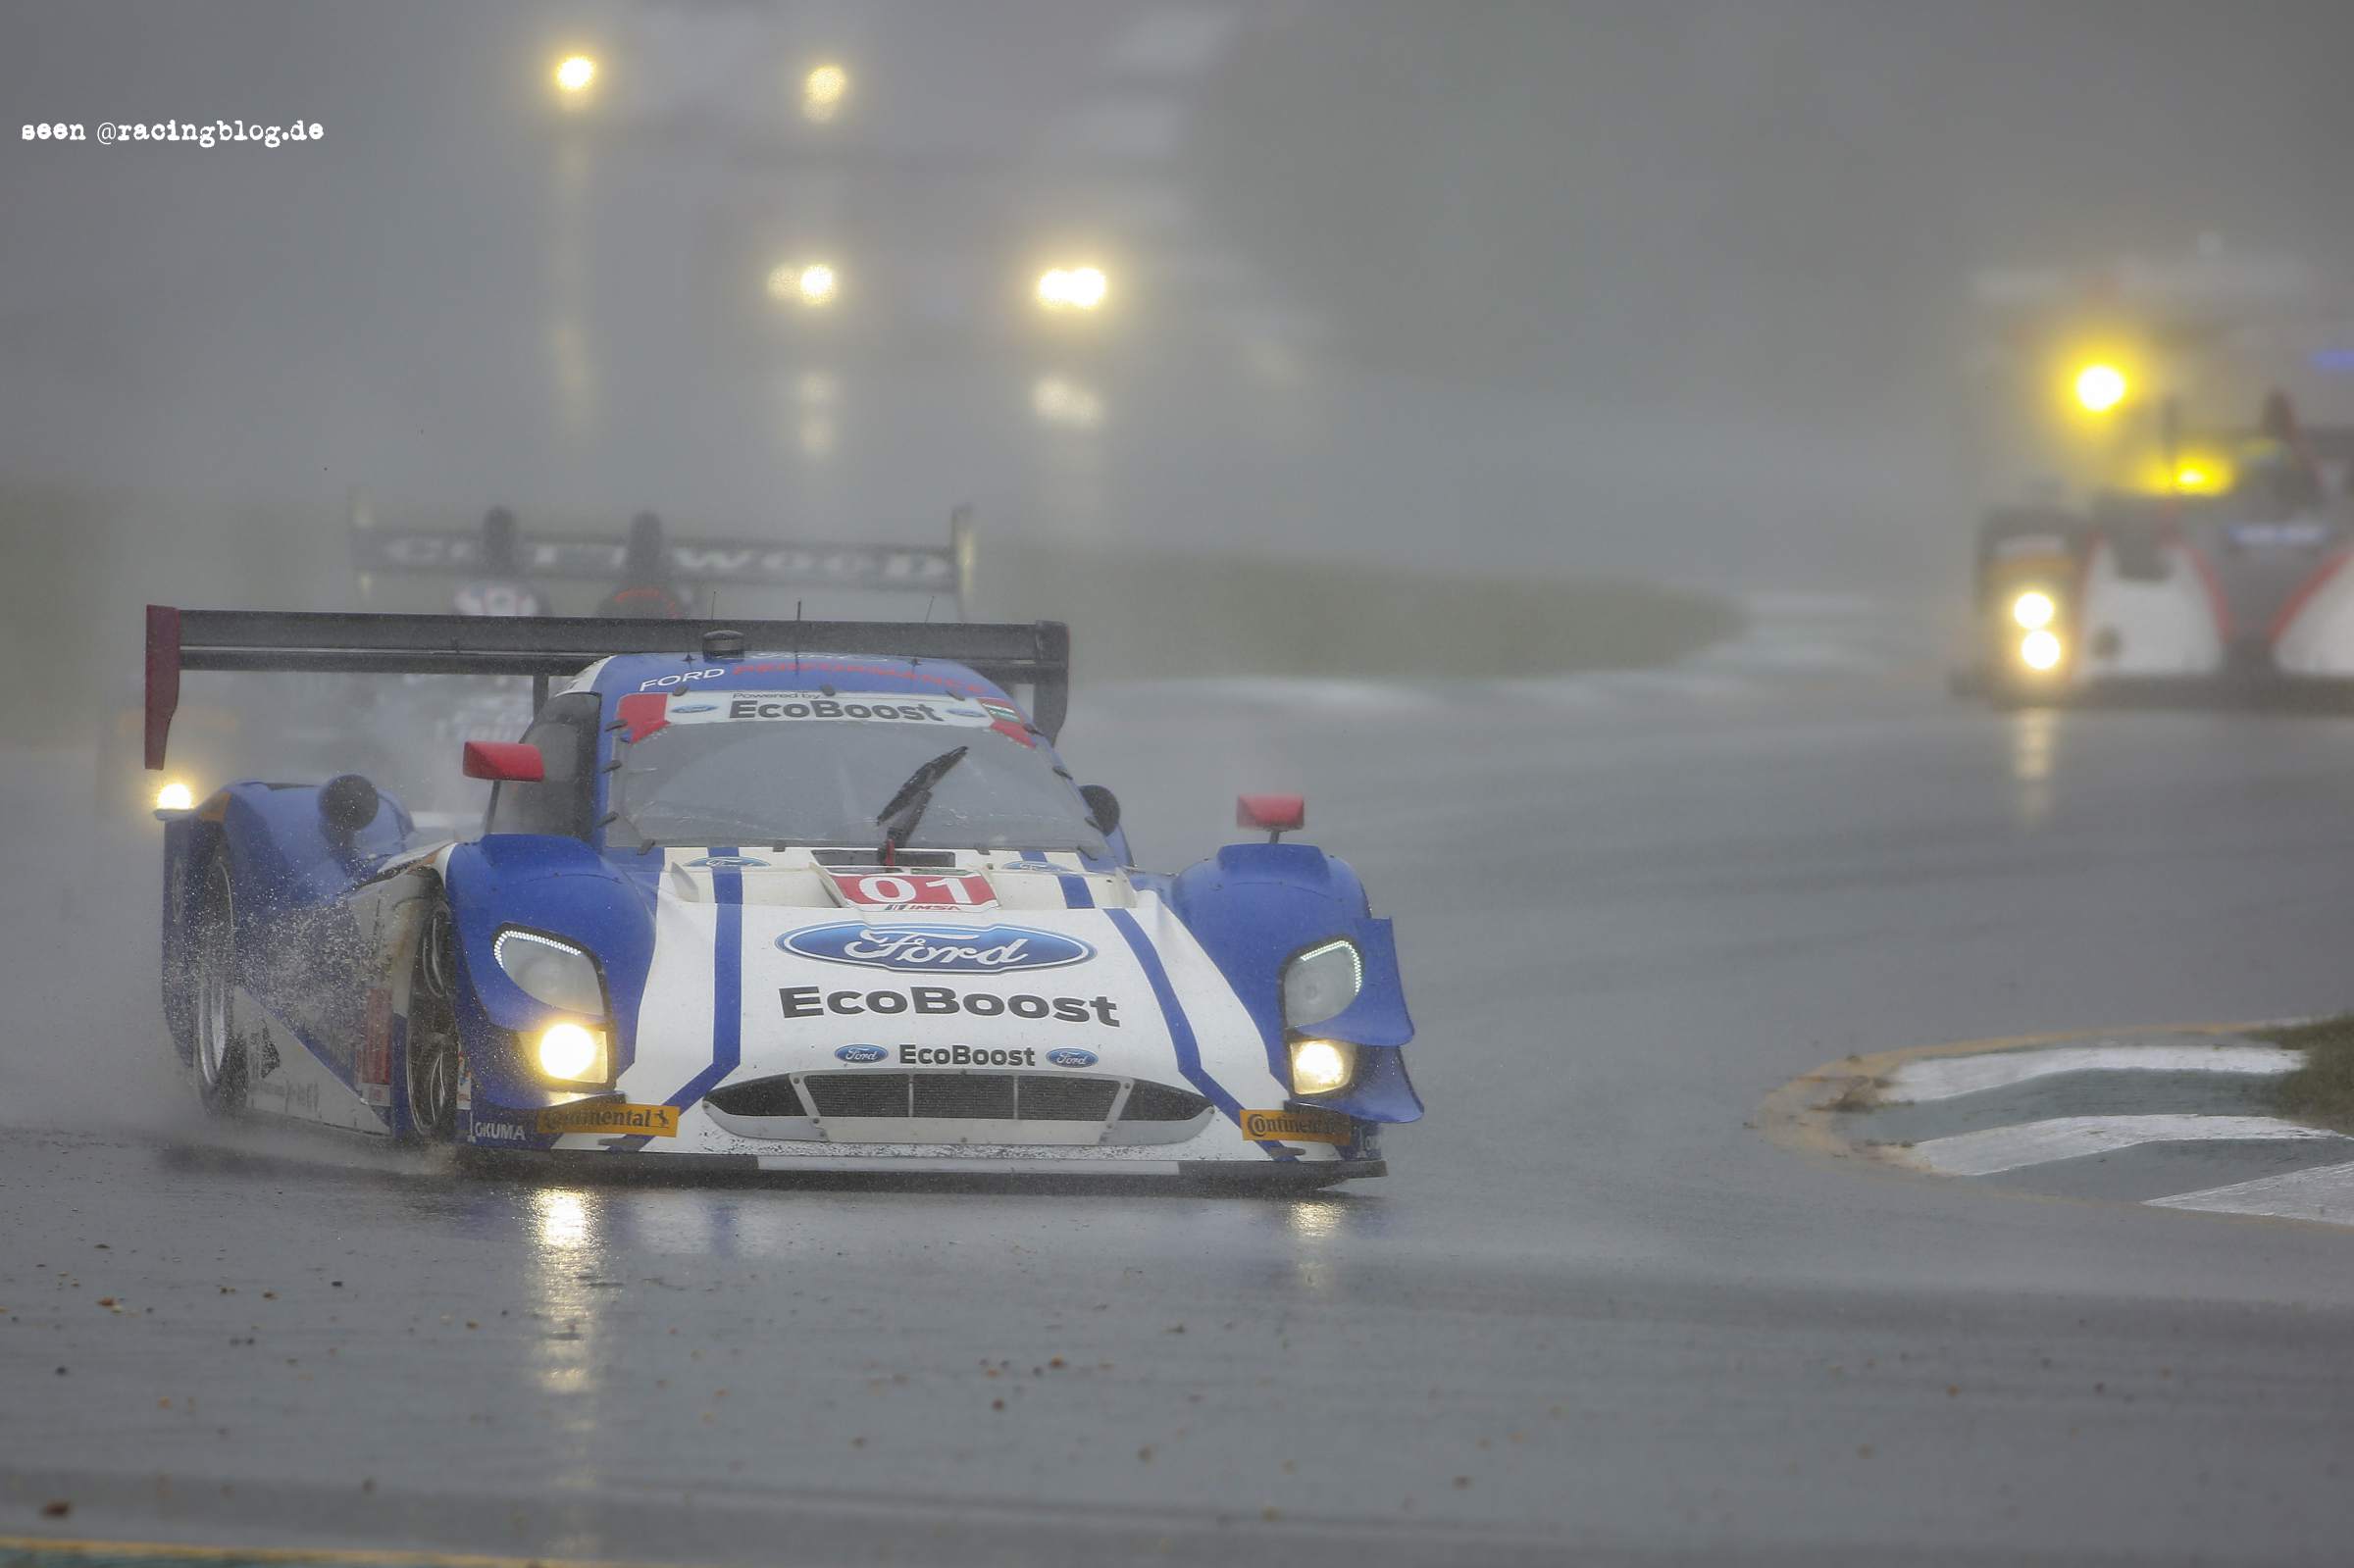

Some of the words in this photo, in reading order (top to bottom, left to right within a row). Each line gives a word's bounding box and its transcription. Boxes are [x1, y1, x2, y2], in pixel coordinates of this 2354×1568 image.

[640, 668, 725, 692] FORD
[730, 700, 945, 722] EcoBoost
[857, 875, 974, 905] 01
[844, 928, 1029, 966] Ford
[778, 985, 1121, 1028] EcoBoost
[844, 1046, 880, 1063] Ford
[898, 1043, 1036, 1067] EcoBoost
[1053, 1050, 1090, 1066] Ford
